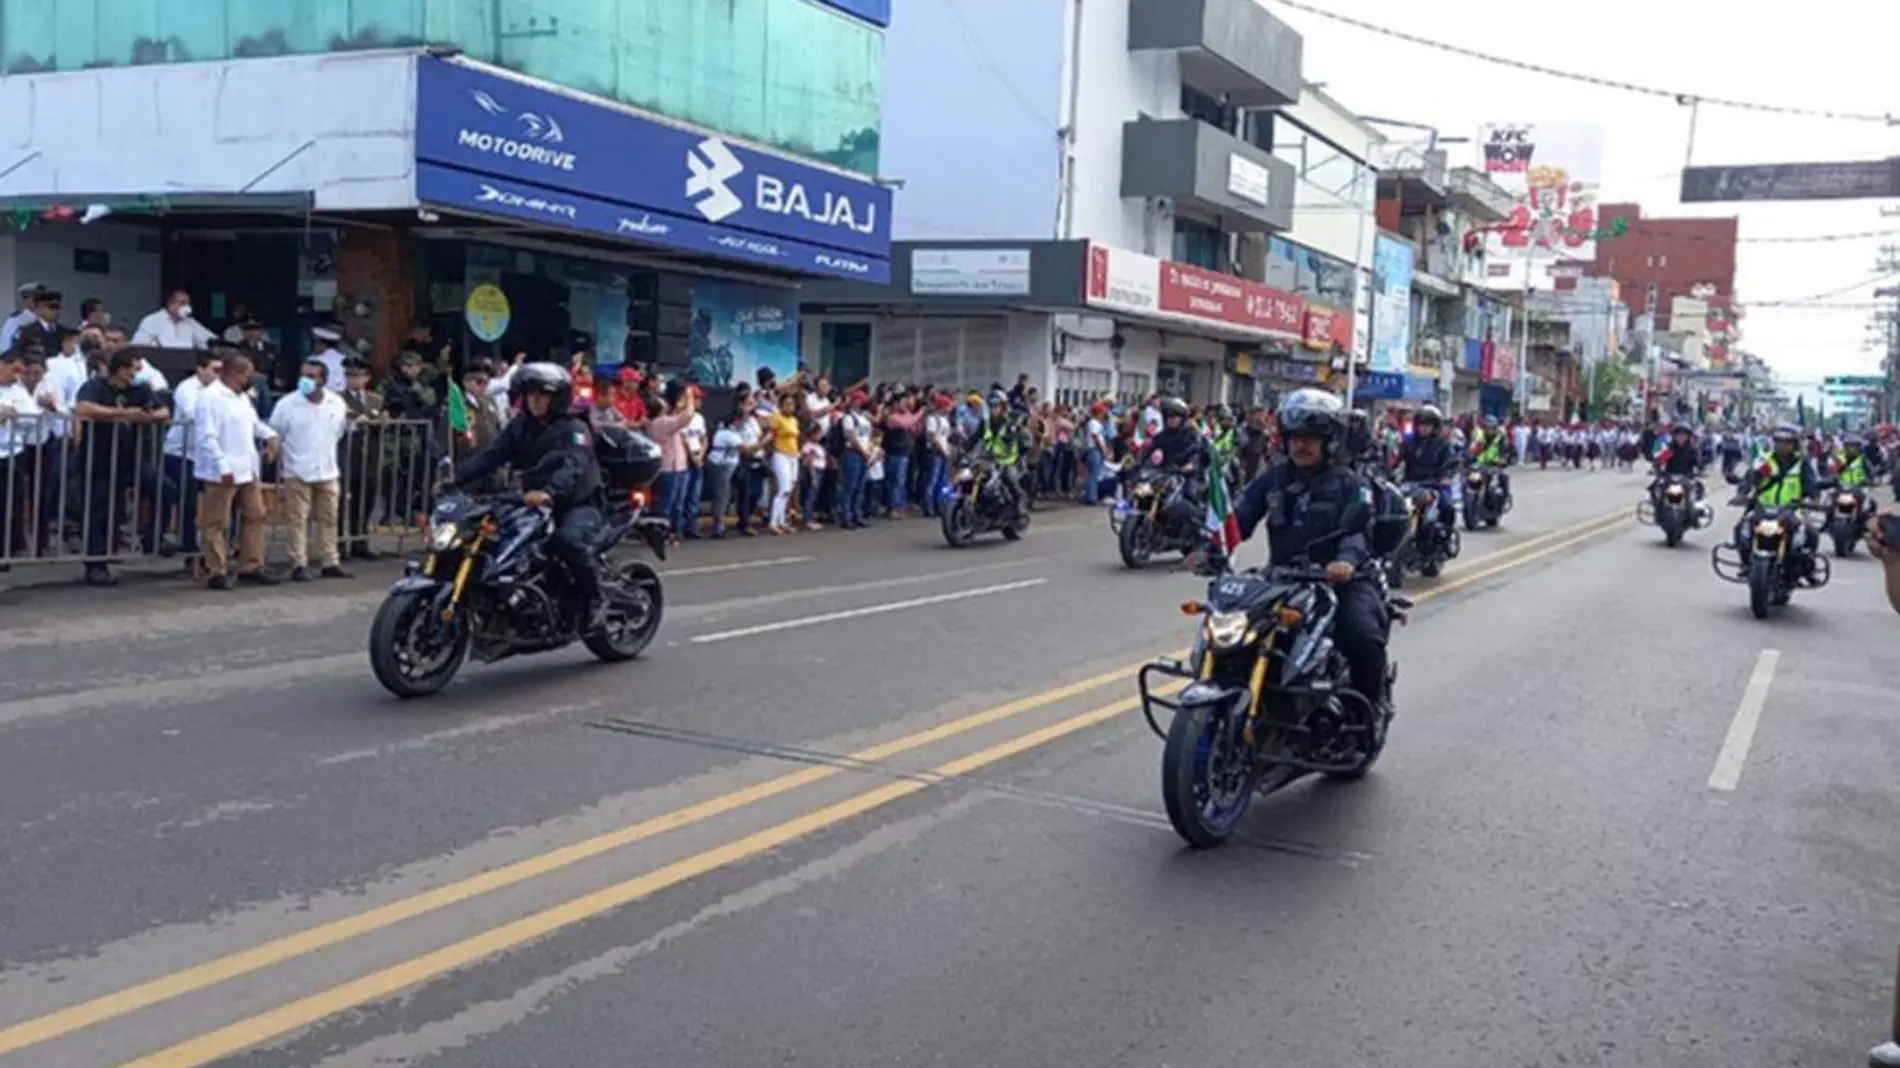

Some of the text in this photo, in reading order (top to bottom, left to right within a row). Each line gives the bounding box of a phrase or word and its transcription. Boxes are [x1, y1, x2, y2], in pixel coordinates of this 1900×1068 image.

[458, 128, 577, 171] MOTODRIVE
[1490, 129, 1529, 143] KFC
[756, 173, 876, 234] BAJAJ
